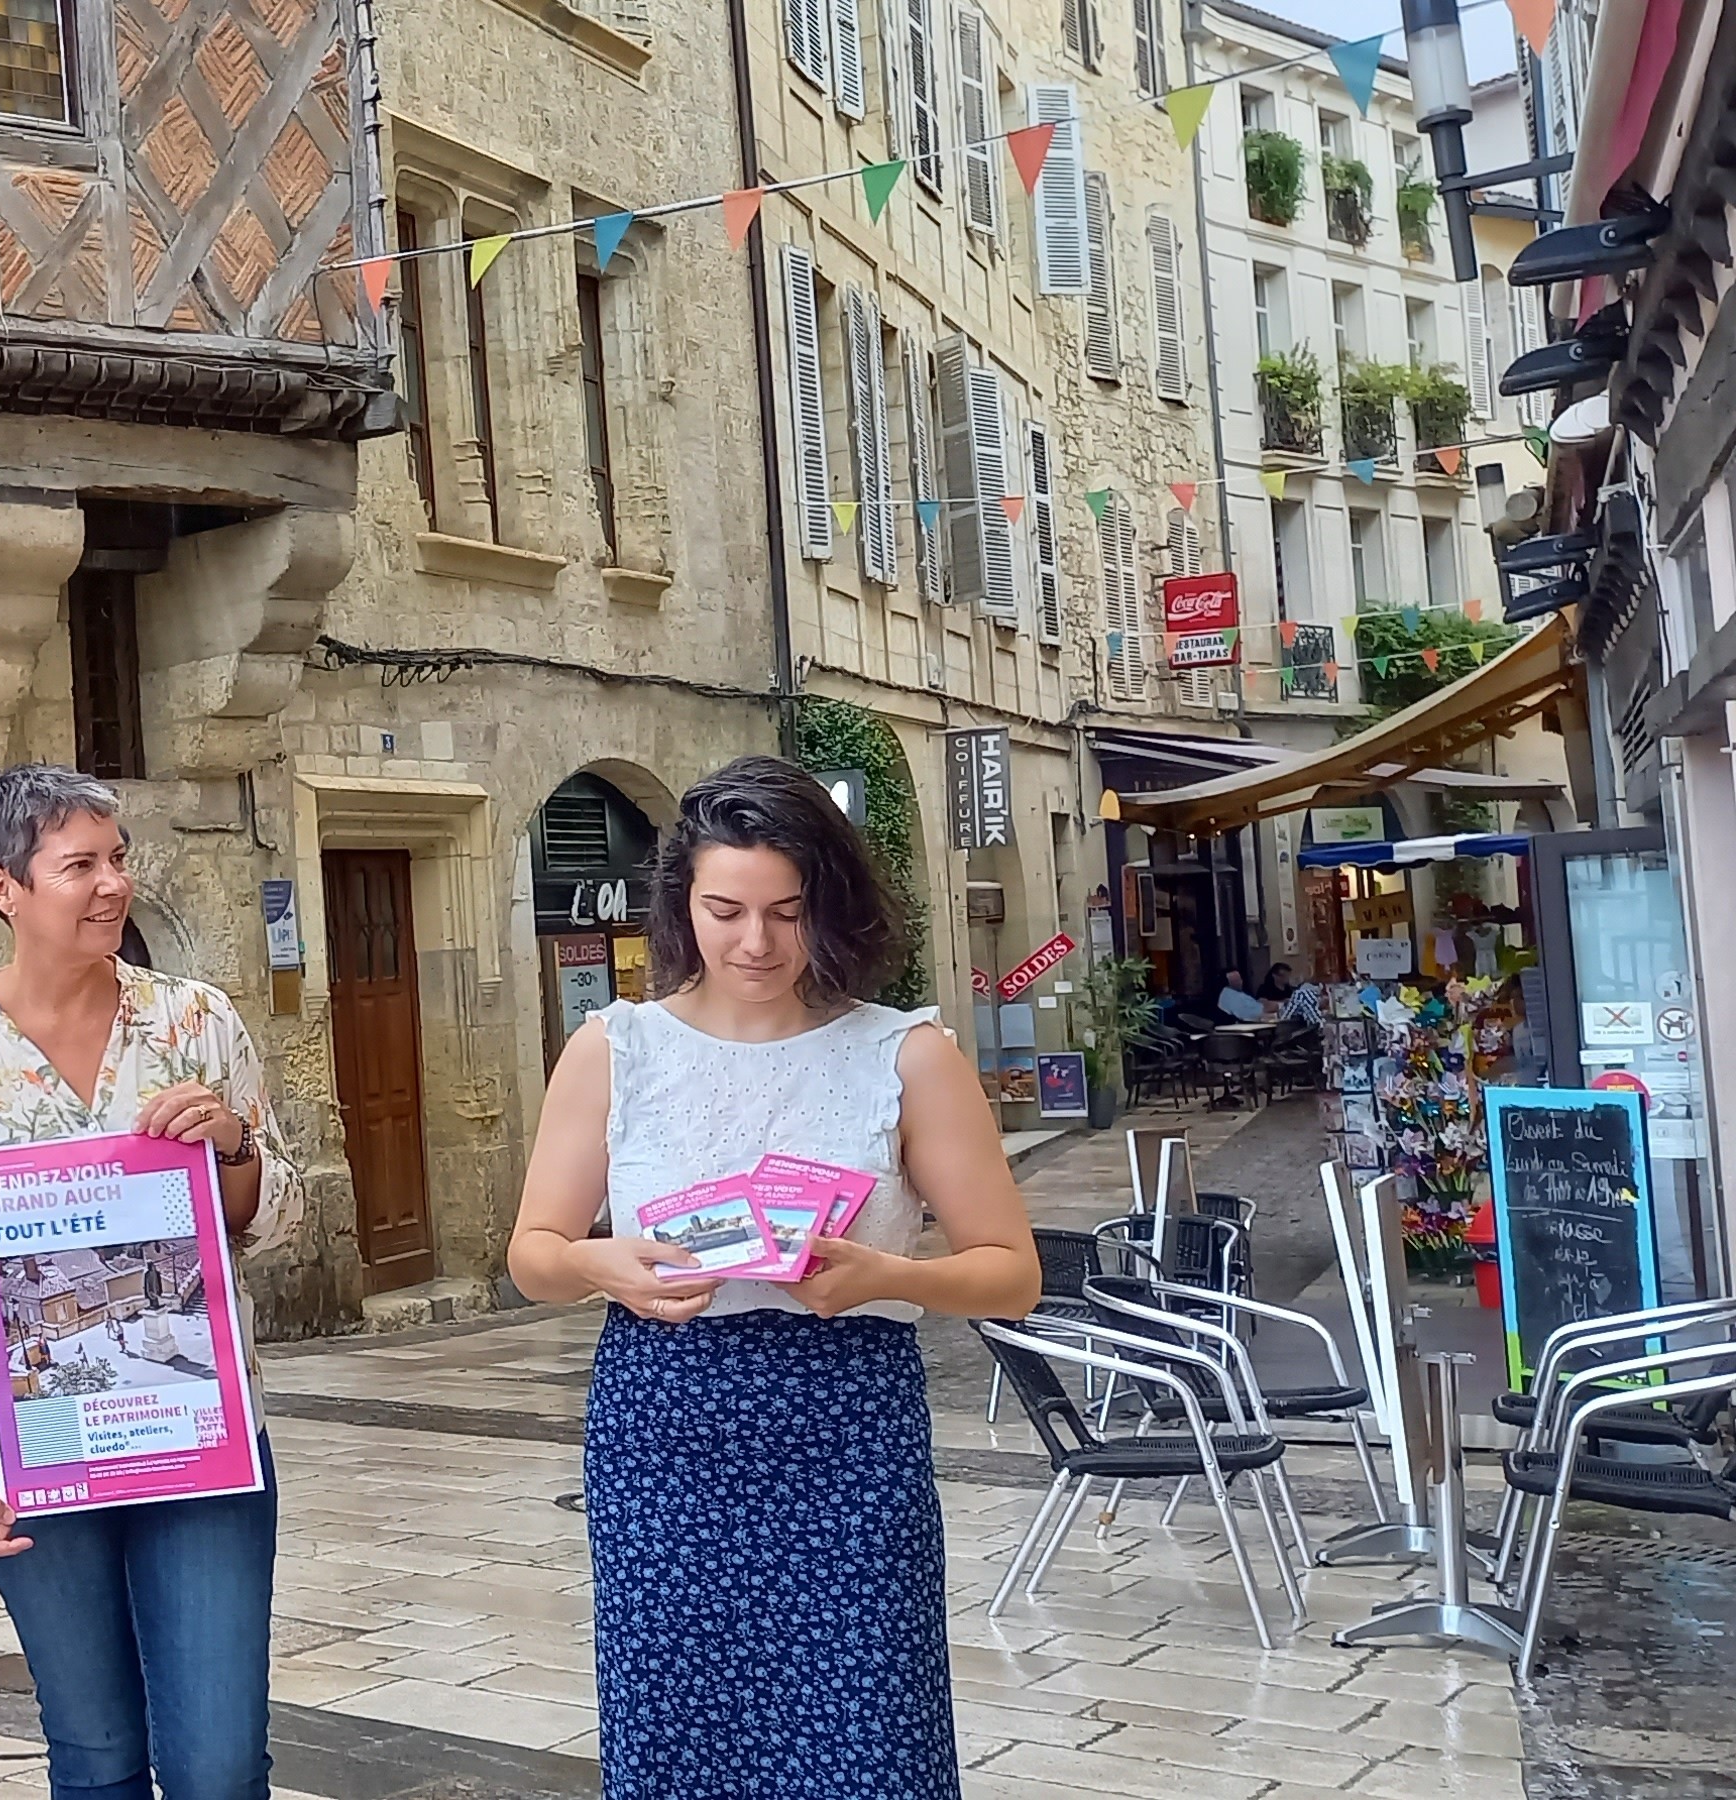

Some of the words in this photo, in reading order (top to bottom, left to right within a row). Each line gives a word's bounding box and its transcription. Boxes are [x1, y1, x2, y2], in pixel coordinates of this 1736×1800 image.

[1175, 637, 1225, 650] ESTAURAN
[1173, 648, 1229, 662] BAR-TAPAS
[384, 736, 392, 749] 3
[955, 737, 972, 848] COIFFURE
[980, 734, 1009, 847] HAIR'IK
[559, 944, 606, 962] SOLDES
[1003, 939, 1068, 995] SOLDES
[1574, 1117, 1603, 1140] du
[65, 1184, 121, 1206] AUCH
[50, 1210, 106, 1235] L'ÉTÉ
[84, 1394, 159, 1412] DÉCOUVREZ
[85, 1415, 100, 1427] LE
[104, 1406, 181, 1424] PATRIMOINE
[87, 1431, 127, 1441] Visites,
